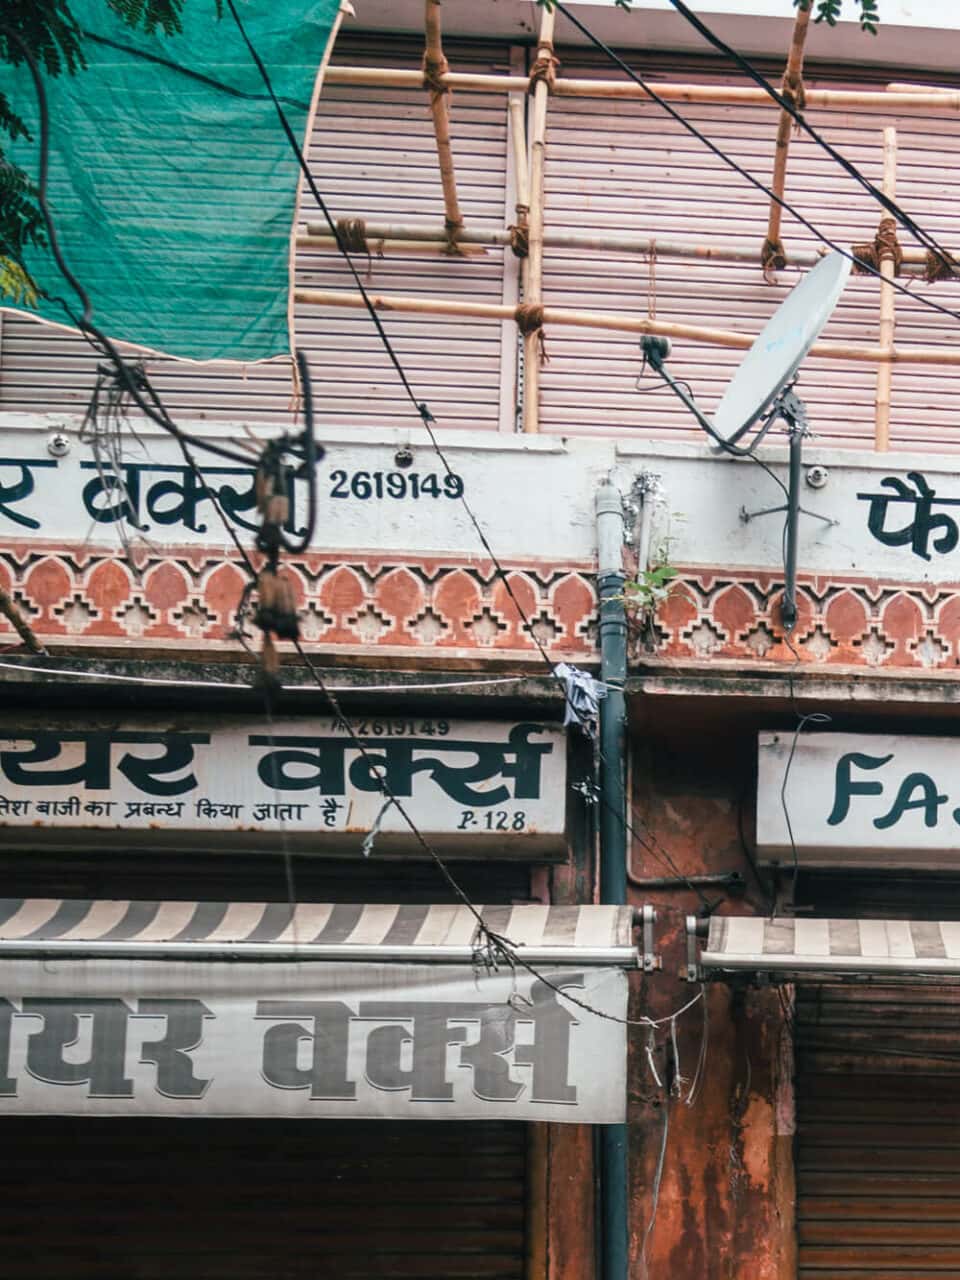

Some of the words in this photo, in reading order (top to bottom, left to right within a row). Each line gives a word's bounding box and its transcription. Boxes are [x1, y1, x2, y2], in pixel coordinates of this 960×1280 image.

[330, 469, 465, 501] 2619149
[358, 718, 450, 736] 2619149
[248, 723, 554, 808] वर्क्स
[124, 801, 187, 819] प्रबन्ध
[196, 798, 244, 819] किया
[252, 802, 309, 821] जाता
[254, 974, 585, 1105] वर्क्स
